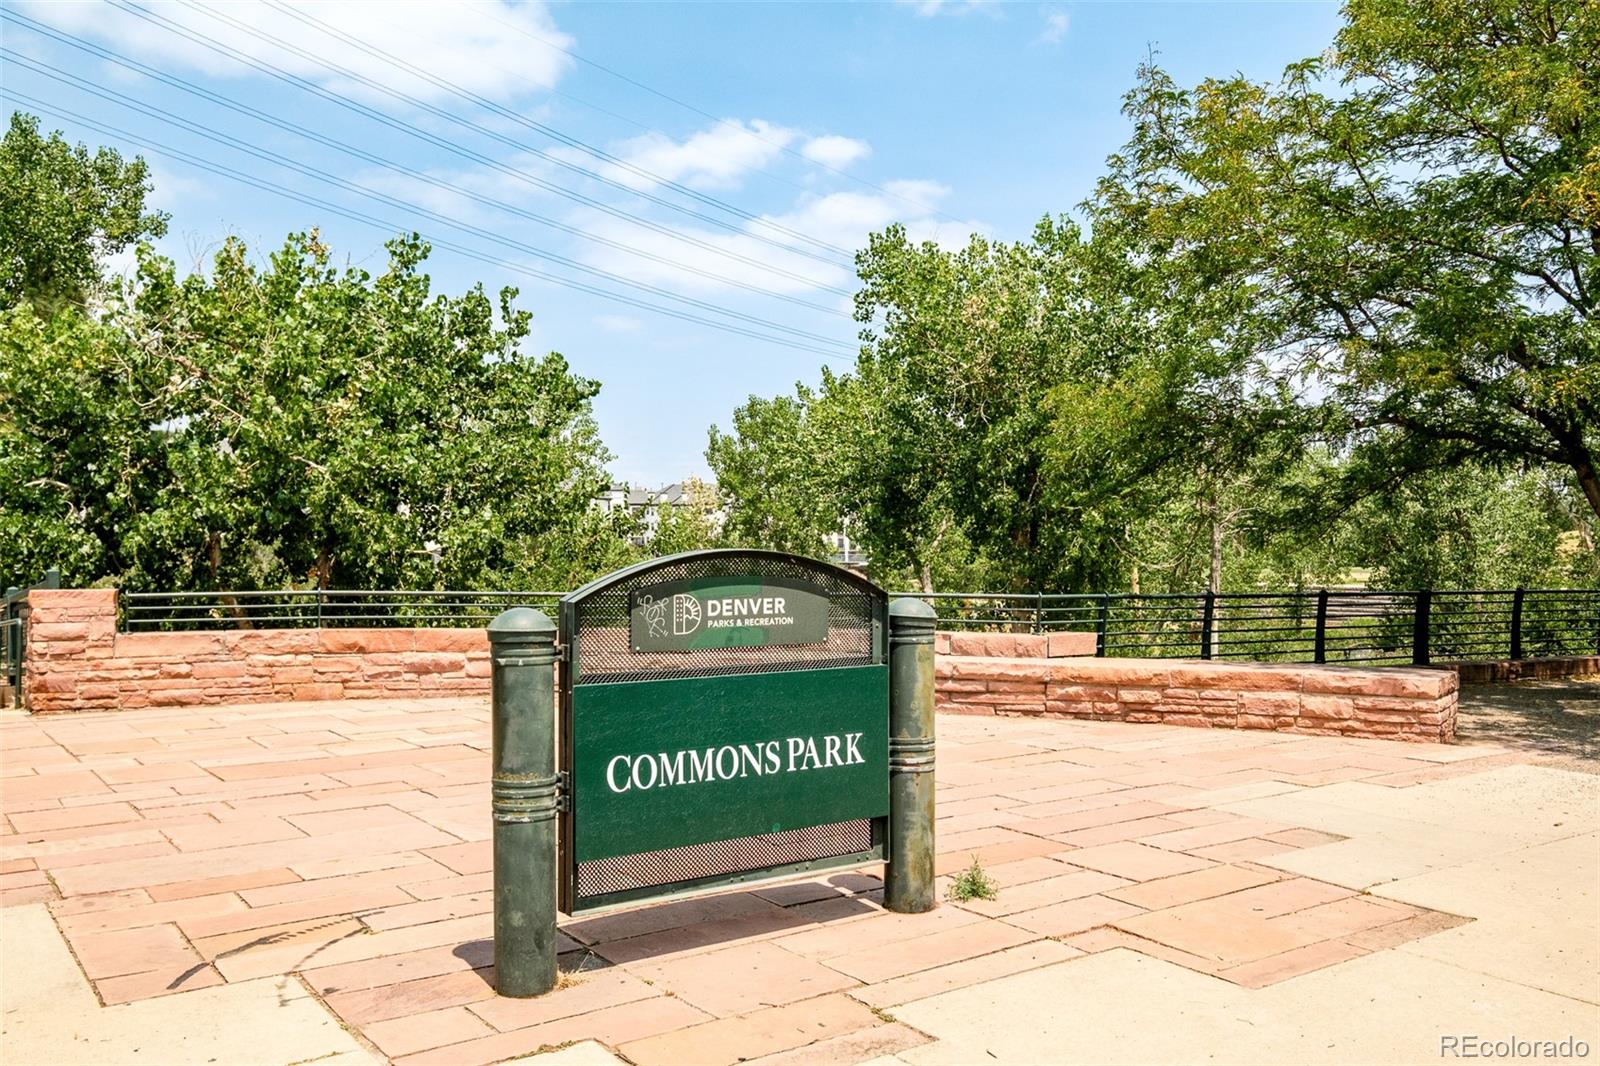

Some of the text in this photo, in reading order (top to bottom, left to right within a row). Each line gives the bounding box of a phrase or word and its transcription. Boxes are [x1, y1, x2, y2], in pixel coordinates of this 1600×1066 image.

[707, 597, 785, 617] DENVER
[707, 616, 794, 628] PARKS & RECREATION
[606, 732, 866, 793] COMMONS PARK
